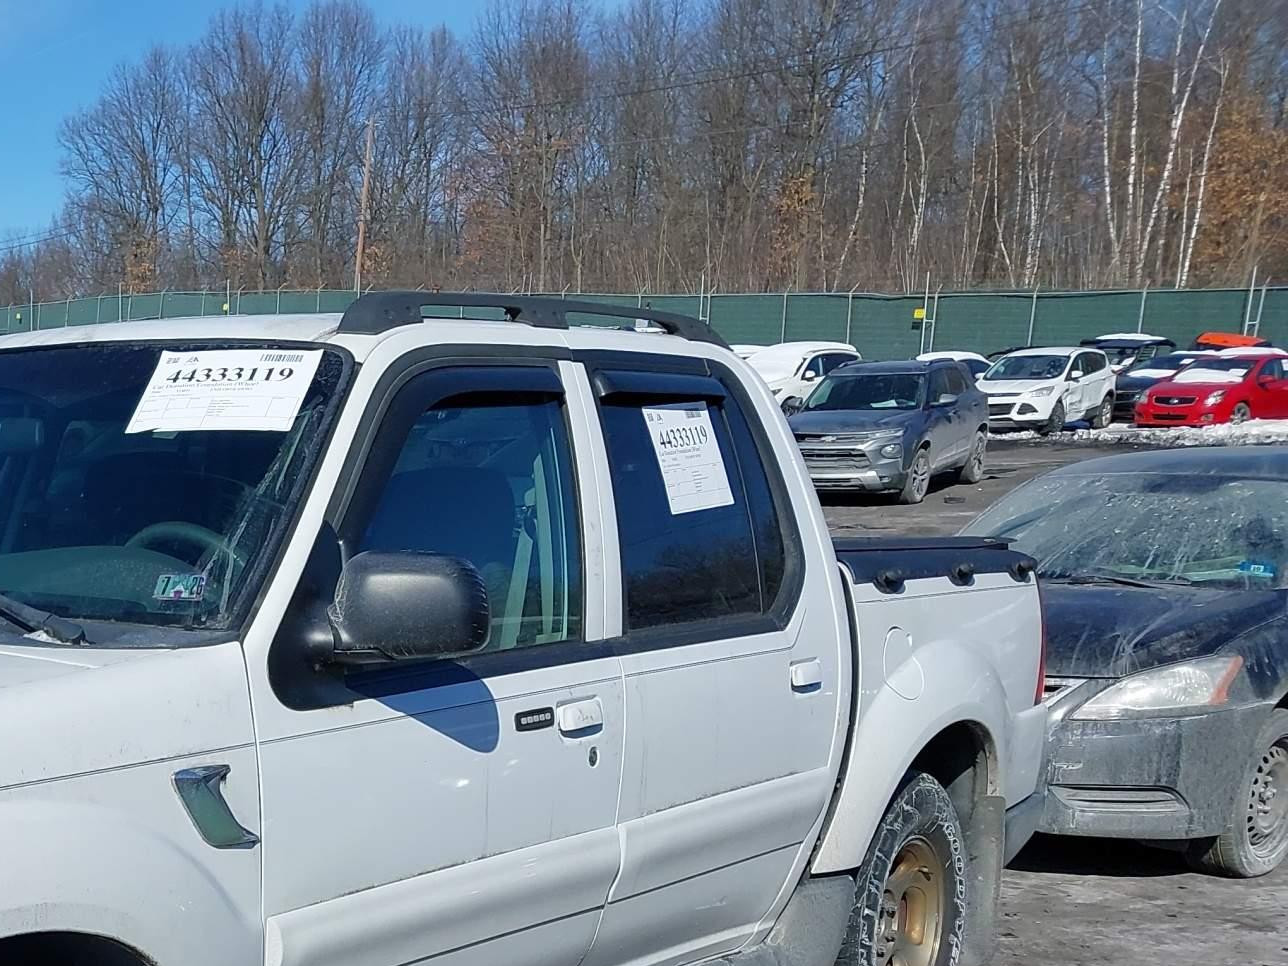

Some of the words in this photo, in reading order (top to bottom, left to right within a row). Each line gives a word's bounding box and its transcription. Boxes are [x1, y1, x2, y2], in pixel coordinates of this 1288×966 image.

[166, 366, 294, 383] 44333119
[659, 425, 708, 449] 44333119
[161, 576, 172, 596] 7
[189, 576, 205, 596] 26
